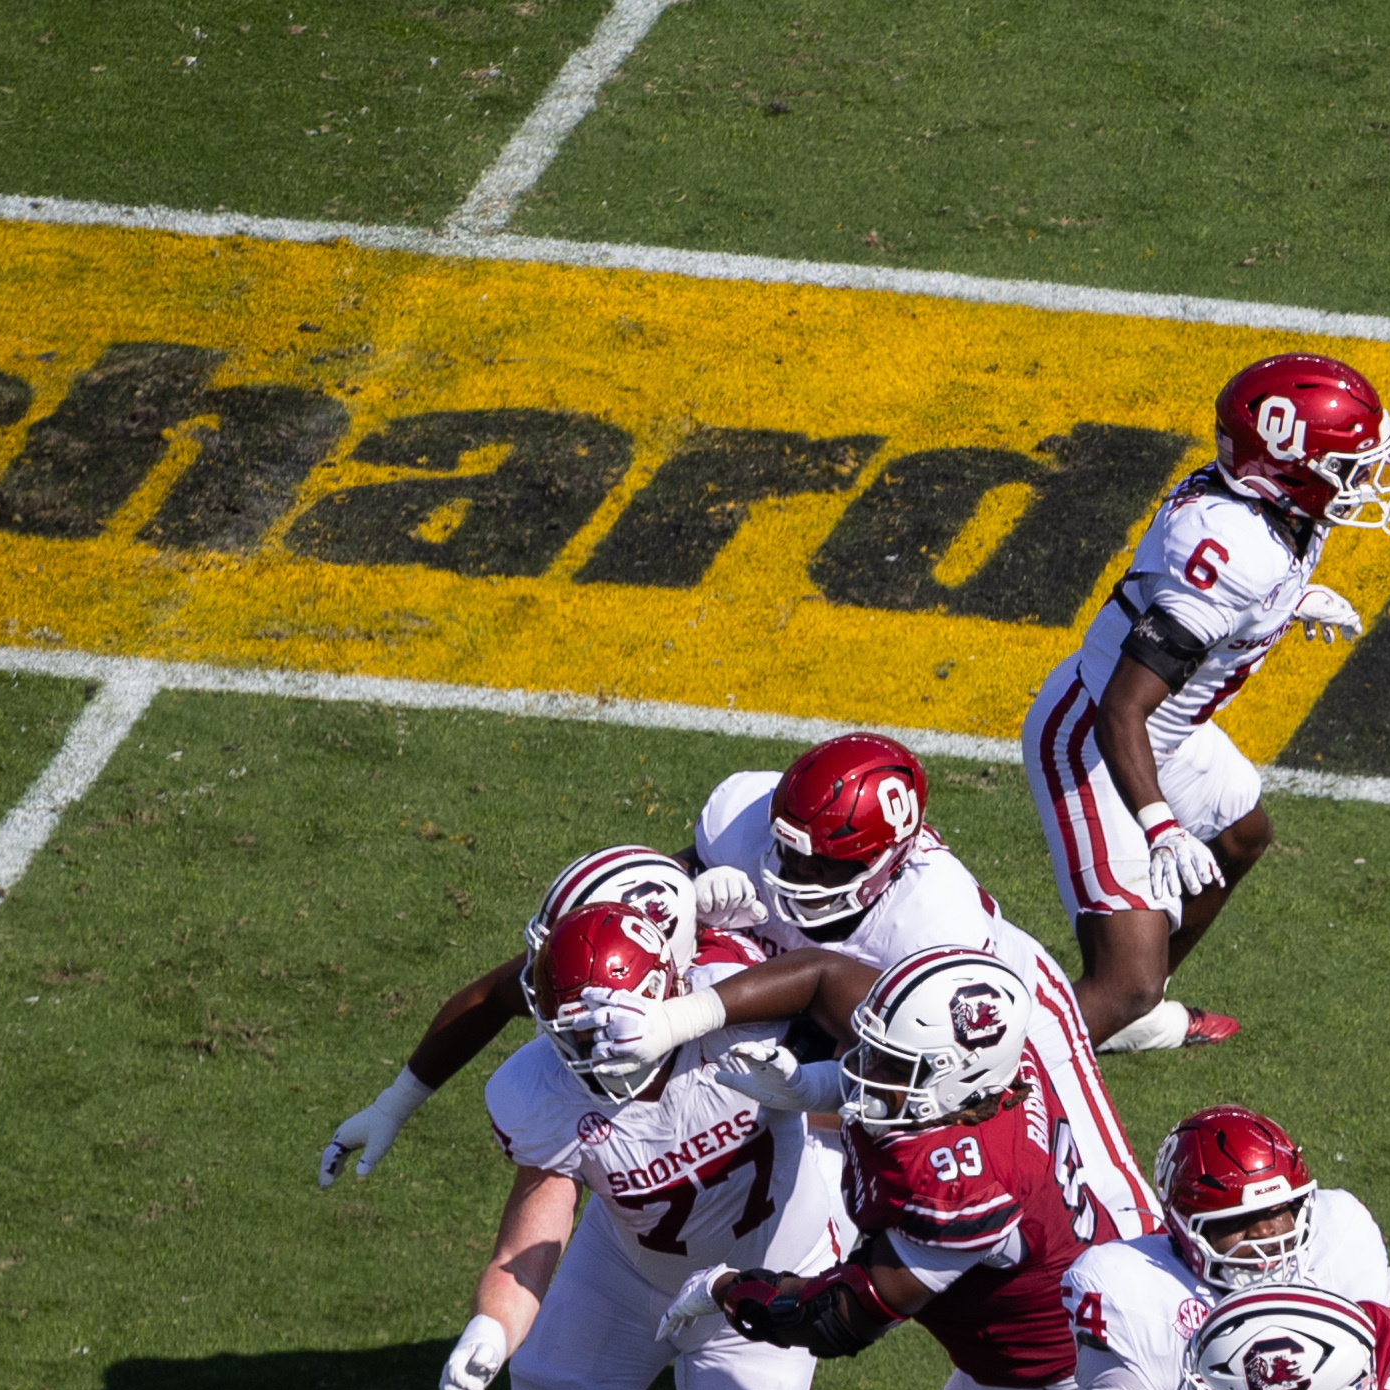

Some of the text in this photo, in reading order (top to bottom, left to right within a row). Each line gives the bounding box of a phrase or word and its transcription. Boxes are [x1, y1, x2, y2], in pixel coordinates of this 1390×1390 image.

[1184, 538, 1230, 591] 6
[607, 1109, 759, 1195] SOONERS
[929, 1136, 984, 1182] 93
[611, 1125, 776, 1257] 77
